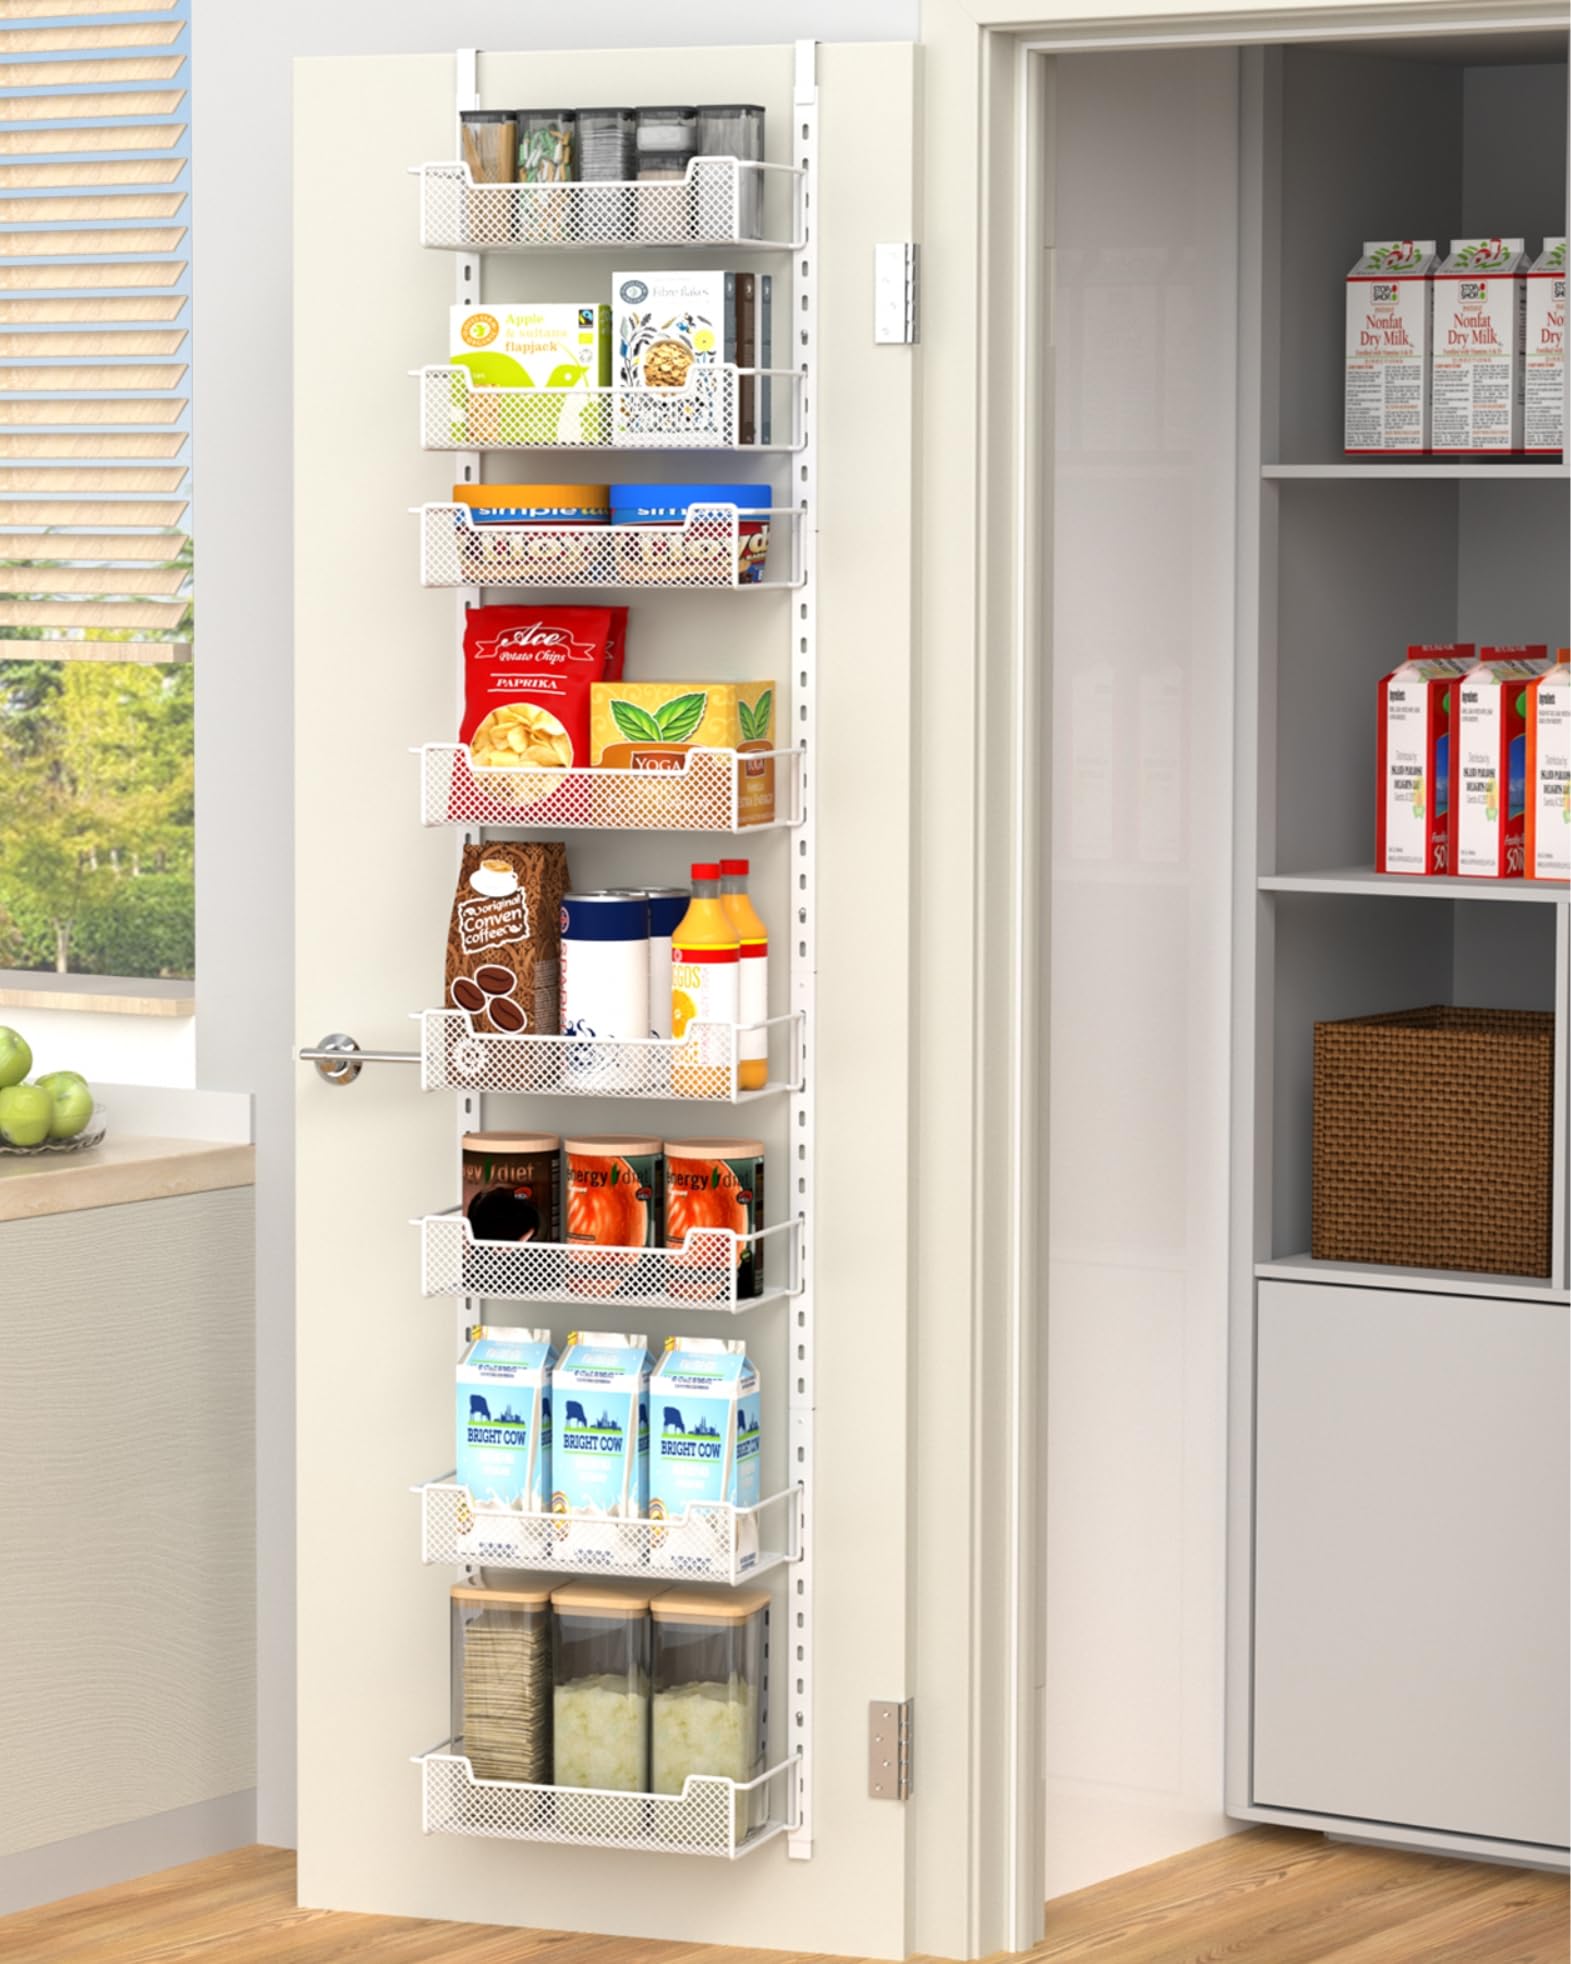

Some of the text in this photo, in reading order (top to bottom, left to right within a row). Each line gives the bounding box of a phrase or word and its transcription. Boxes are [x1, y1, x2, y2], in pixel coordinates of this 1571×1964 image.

[506, 313, 544, 327] Apple
[1366, 312, 1403, 330] Nonfat
[1454, 311, 1491, 329] Nonfat
[1360, 330, 1409, 350] Dry Milk
[1448, 328, 1498, 348] Dry Milk
[1541, 328, 1562, 347] Dry
[506, 341, 558, 354] flapjack
[501, 621, 567, 647] Ace
[500, 650, 566, 664] Potato Chips
[496, 678, 558, 689] PAPRIKA
[636, 757, 681, 770] YOGA
[481, 894, 522, 914] original
[464, 908, 523, 933] Conven
[465, 926, 508, 944] coffee
[497, 1162, 534, 1181] diet
[467, 1427, 503, 1444] BRIGHT
[503, 1430, 526, 1445] COW
[563, 1434, 599, 1450] BRIGHT
[600, 1436, 623, 1452] COW
[661, 1440, 697, 1457] BRIGHT
[698, 1442, 721, 1458] COW
